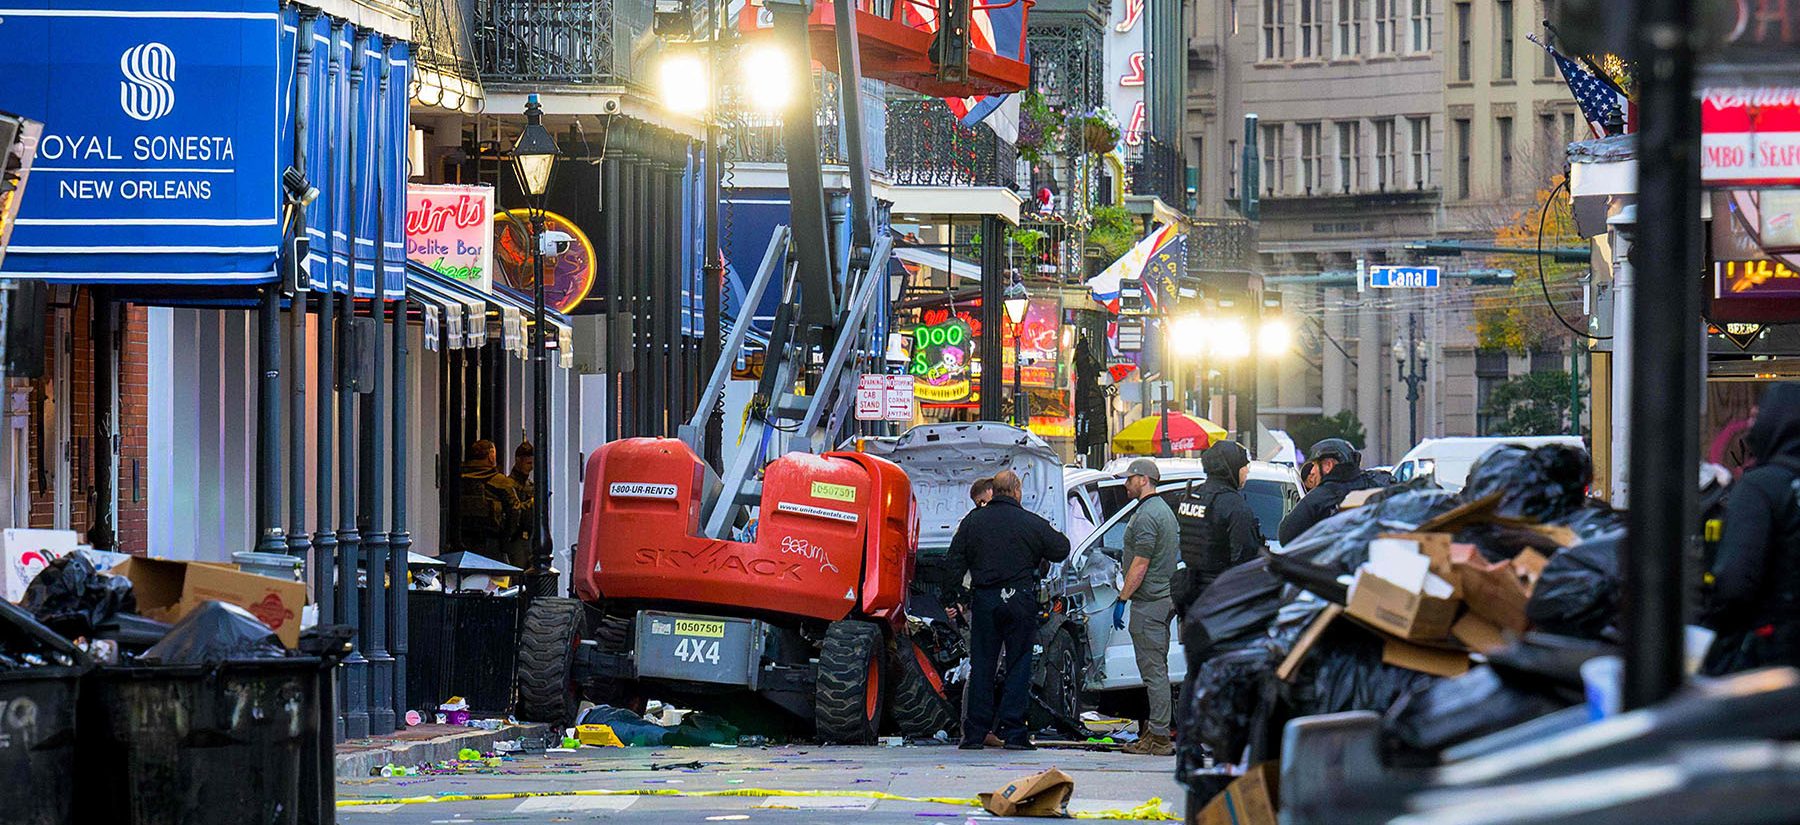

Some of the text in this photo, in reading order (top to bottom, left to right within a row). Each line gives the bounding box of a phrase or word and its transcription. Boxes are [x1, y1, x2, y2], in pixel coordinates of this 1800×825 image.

[133, 136, 234, 161] SONESTA
[60, 180, 211, 200] NEW ORLEANS
[408, 238, 482, 255] Delite Bar
[1388, 269, 1427, 287] Canal
[863, 391, 876, 399] CAB
[860, 401, 880, 409] STAND
[779, 503, 857, 521] www.unitedrentals.com
[676, 621, 724, 634] 10507501
[674, 638, 720, 665] 4X4
